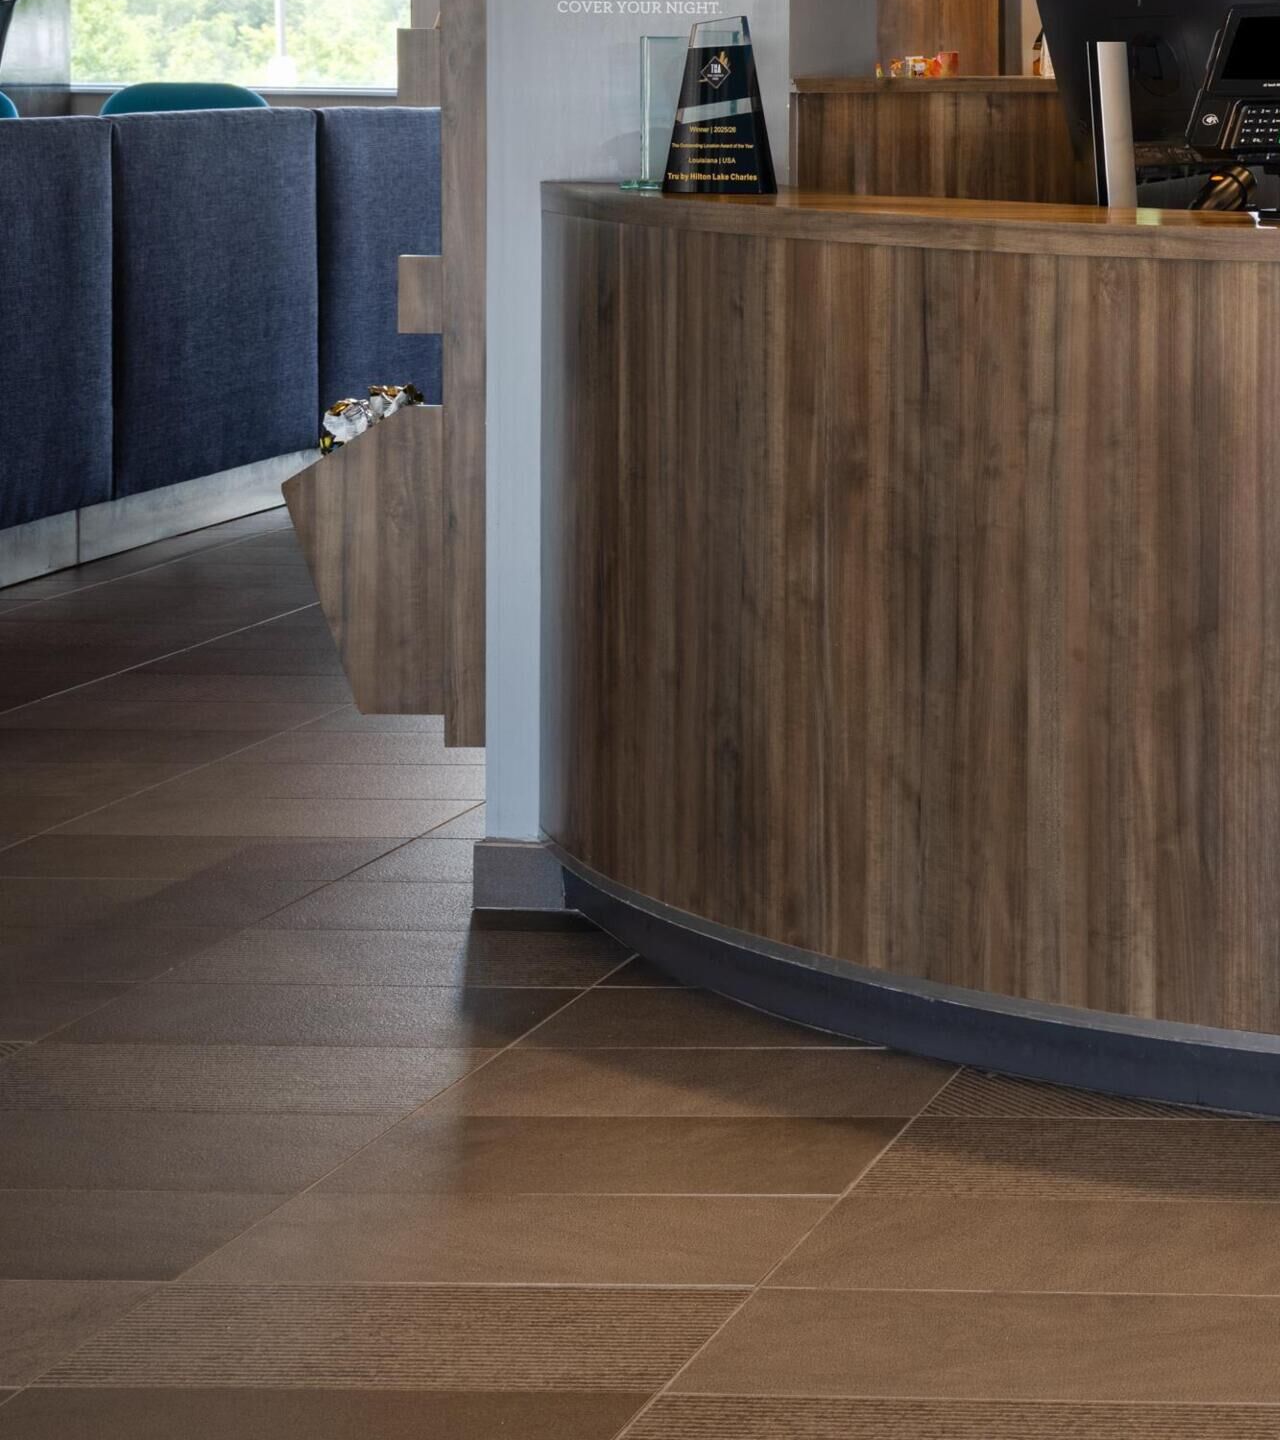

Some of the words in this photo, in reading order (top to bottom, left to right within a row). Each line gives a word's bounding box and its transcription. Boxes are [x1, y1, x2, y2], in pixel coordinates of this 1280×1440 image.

[557, 0, 613, 13] COVER
[616, 1, 662, 13] YOUR
[665, 1, 722, 15] NIGHT.
[681, 173, 689, 182] by
[712, 173, 729, 181] Lake
[730, 173, 758, 181] Charles
